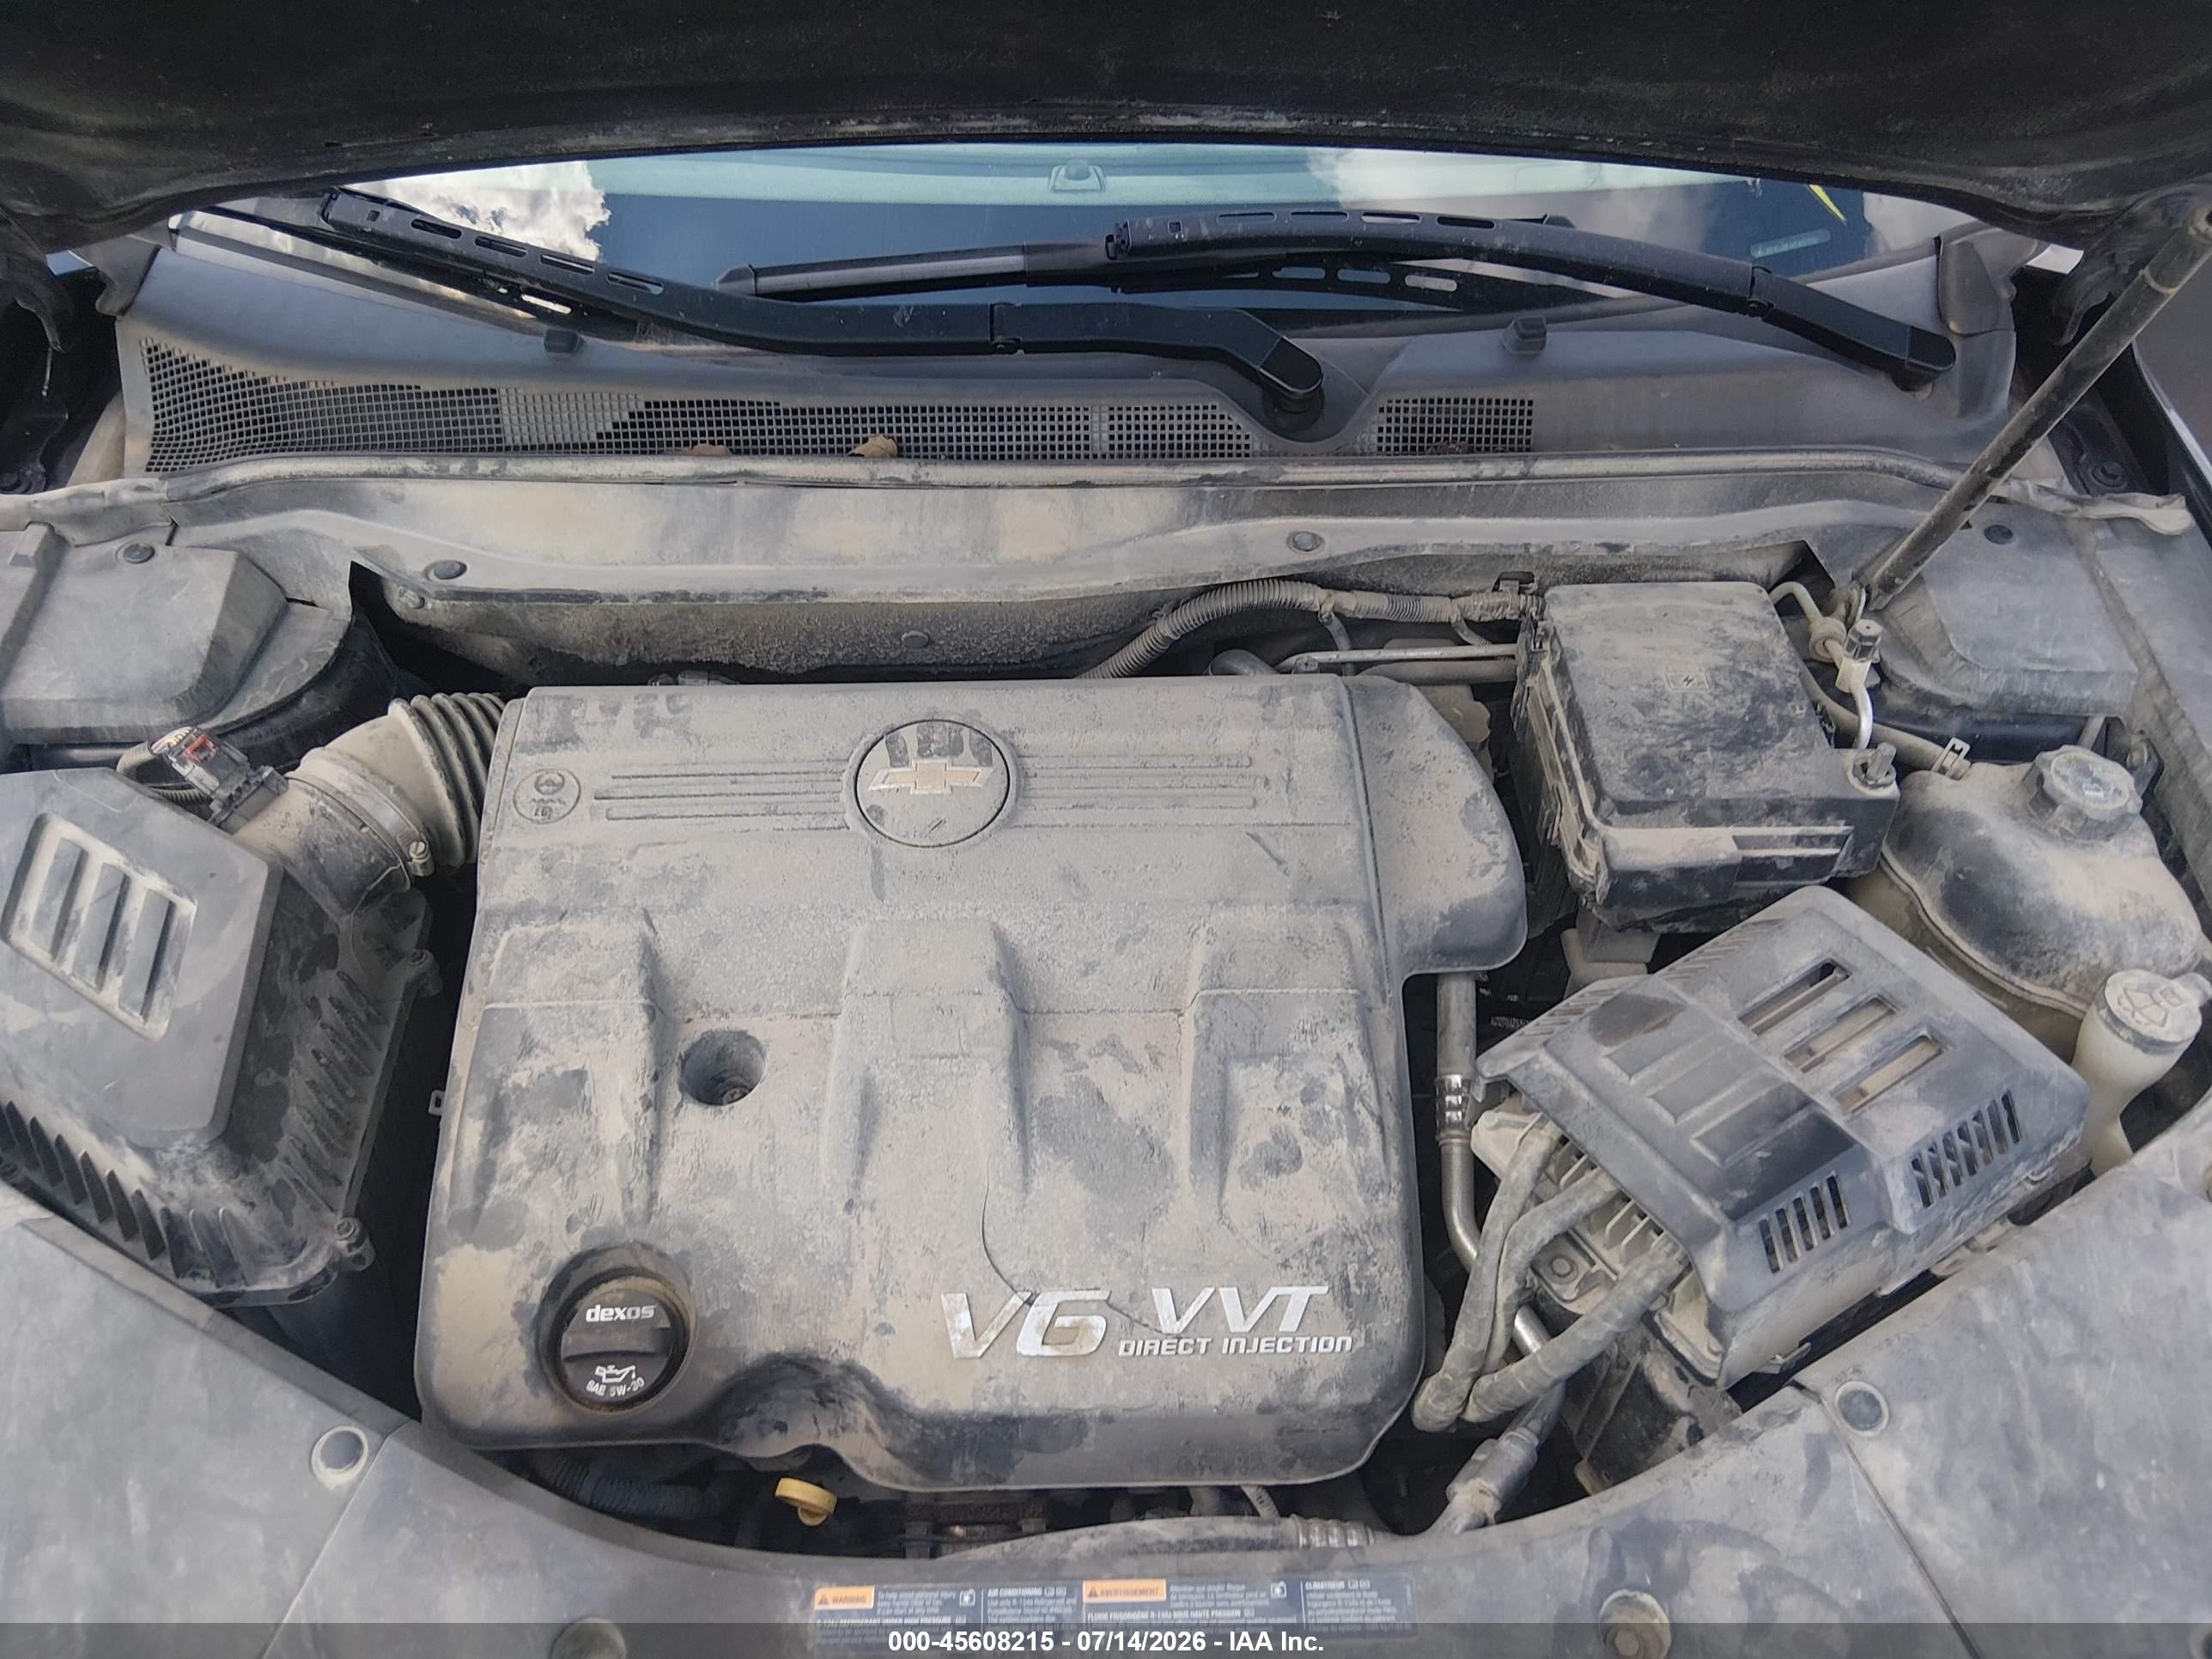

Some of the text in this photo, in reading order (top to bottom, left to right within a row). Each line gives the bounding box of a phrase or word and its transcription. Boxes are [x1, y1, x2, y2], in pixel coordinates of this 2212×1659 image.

[586, 1304, 657, 1322] dexos
[940, 1285, 1330, 1359] V6 VVT
[1118, 1335, 1353, 1357] DIRECT INJECTION
[586, 1379, 606, 1396] SAE
[831, 1595, 866, 1604] WARNING
[1100, 1587, 1159, 1598] AVERTISSEMENT
